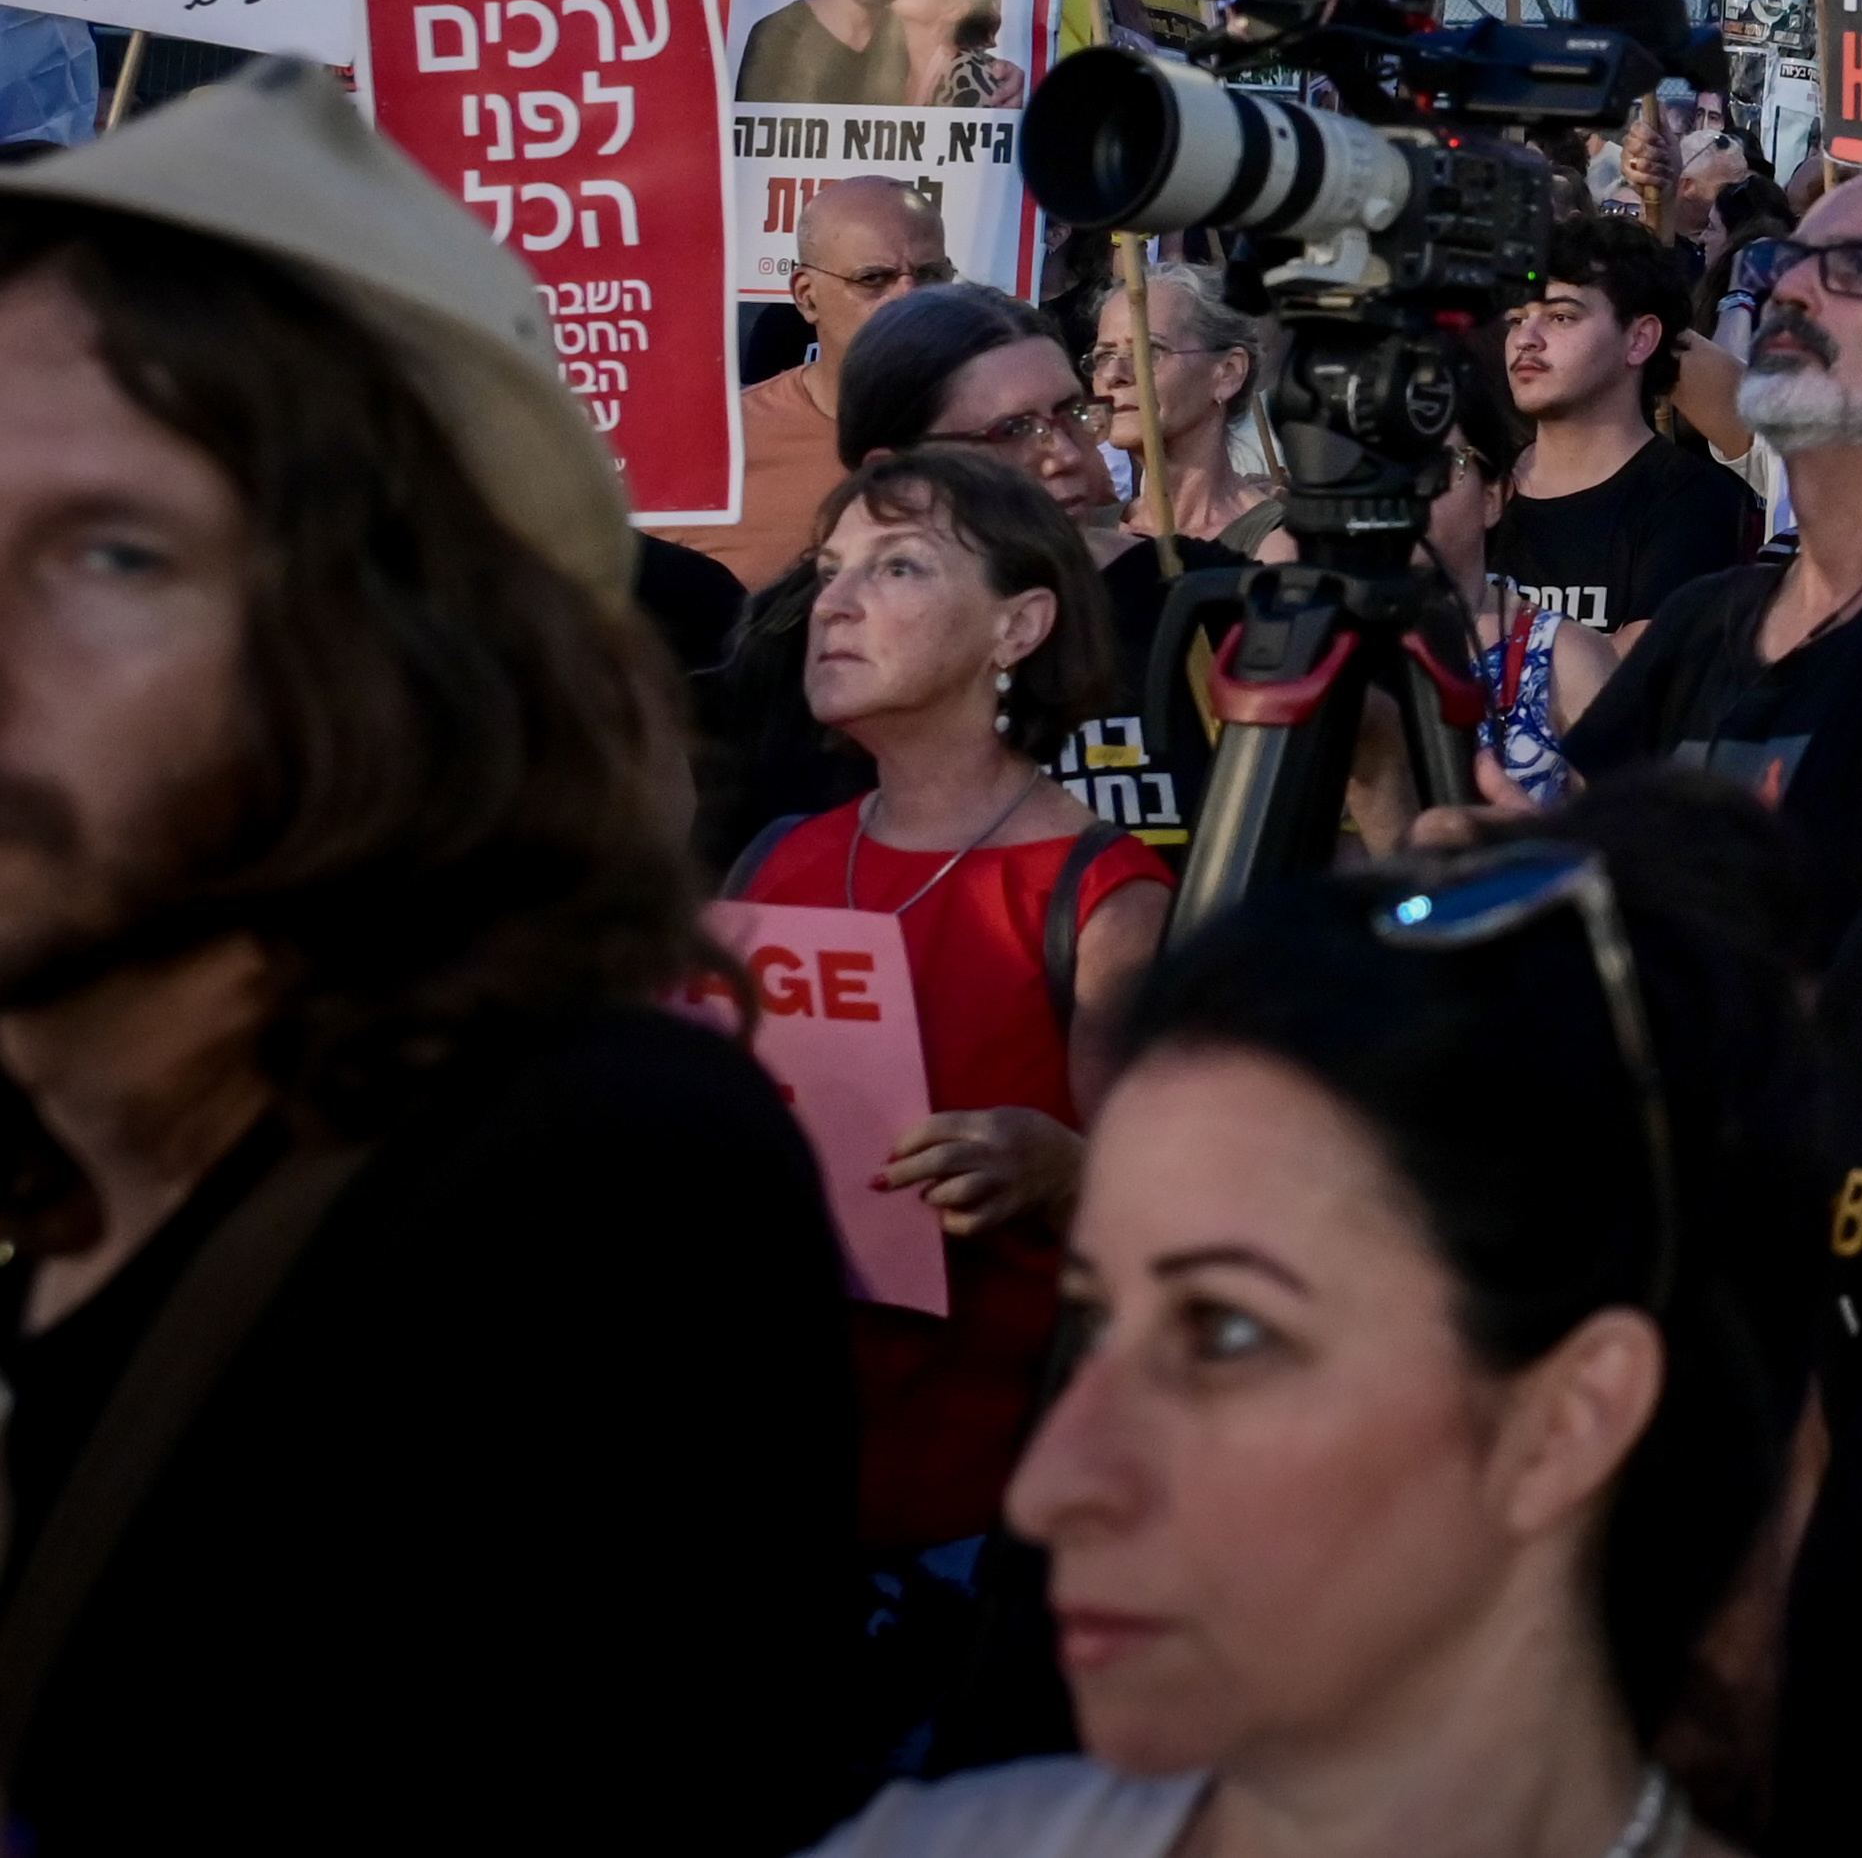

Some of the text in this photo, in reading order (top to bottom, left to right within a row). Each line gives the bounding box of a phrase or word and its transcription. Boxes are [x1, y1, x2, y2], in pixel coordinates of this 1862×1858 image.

[461, 66, 636, 163] לפני
[732, 116, 925, 163] אמא מחכה
[464, 172, 641, 252] הכל
